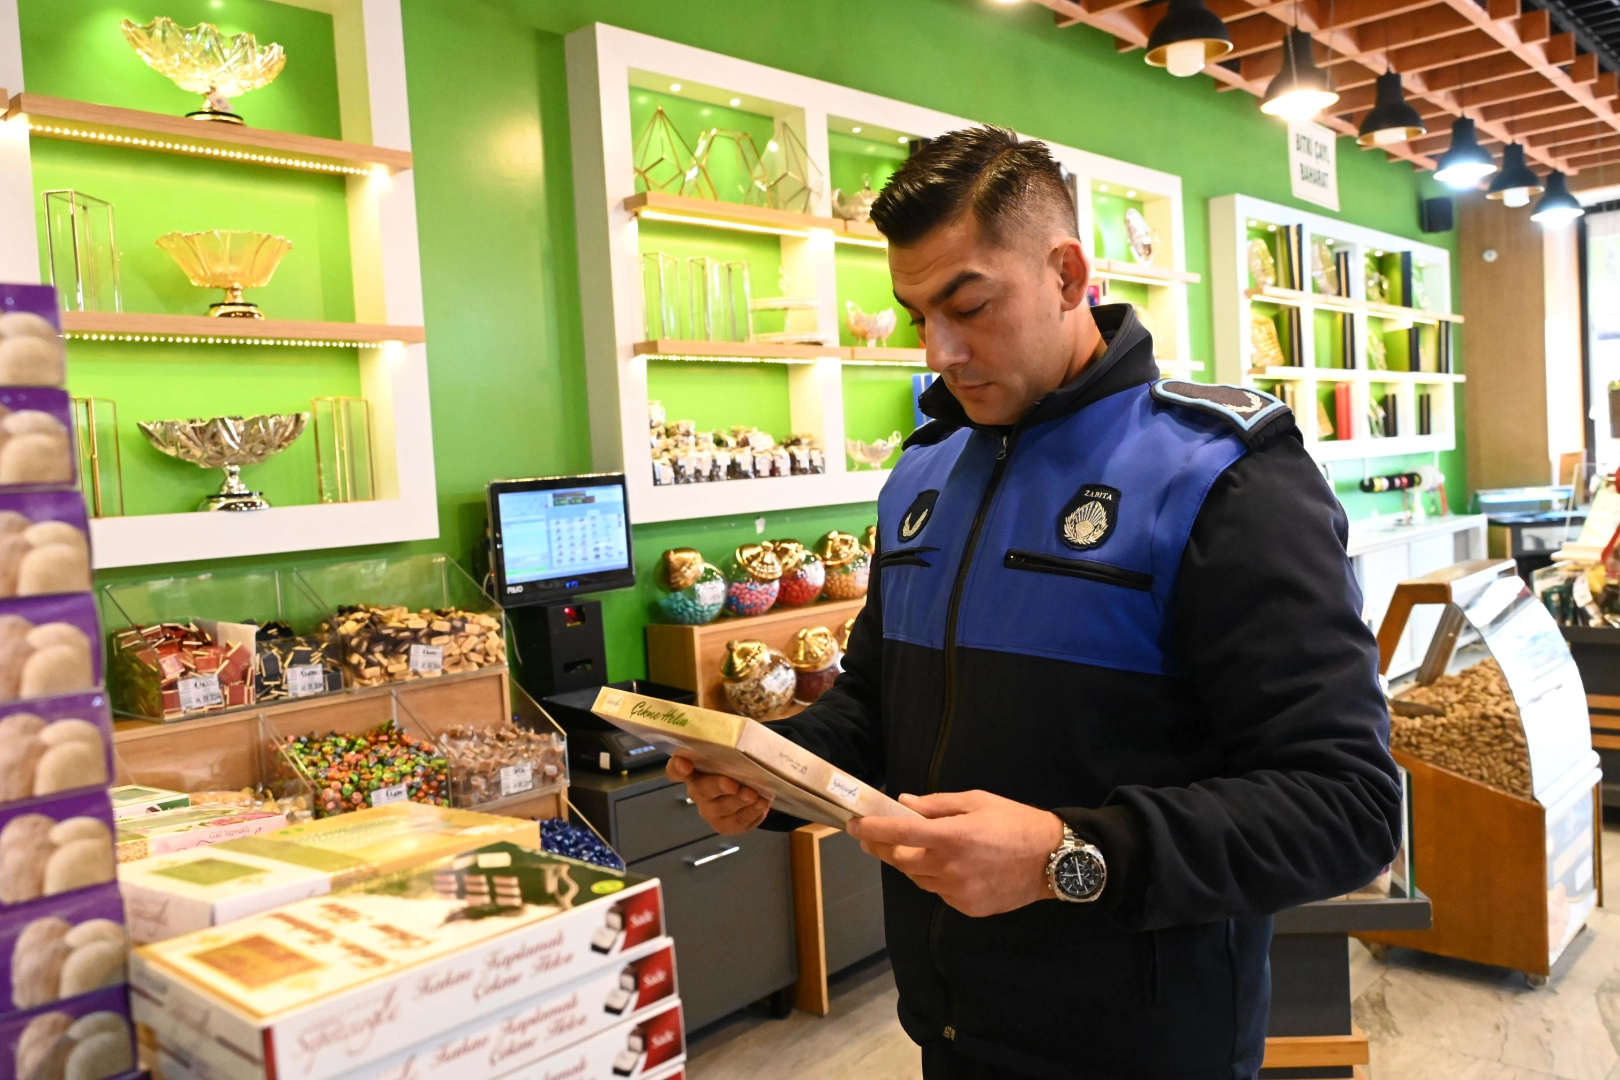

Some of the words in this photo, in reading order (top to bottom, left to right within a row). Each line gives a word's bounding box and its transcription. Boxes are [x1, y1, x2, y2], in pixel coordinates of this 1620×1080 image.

[1300, 163, 1328, 188] BAHARAT
[1084, 489, 1112, 500] ZABITA
[209, 830, 223, 839] Gül
